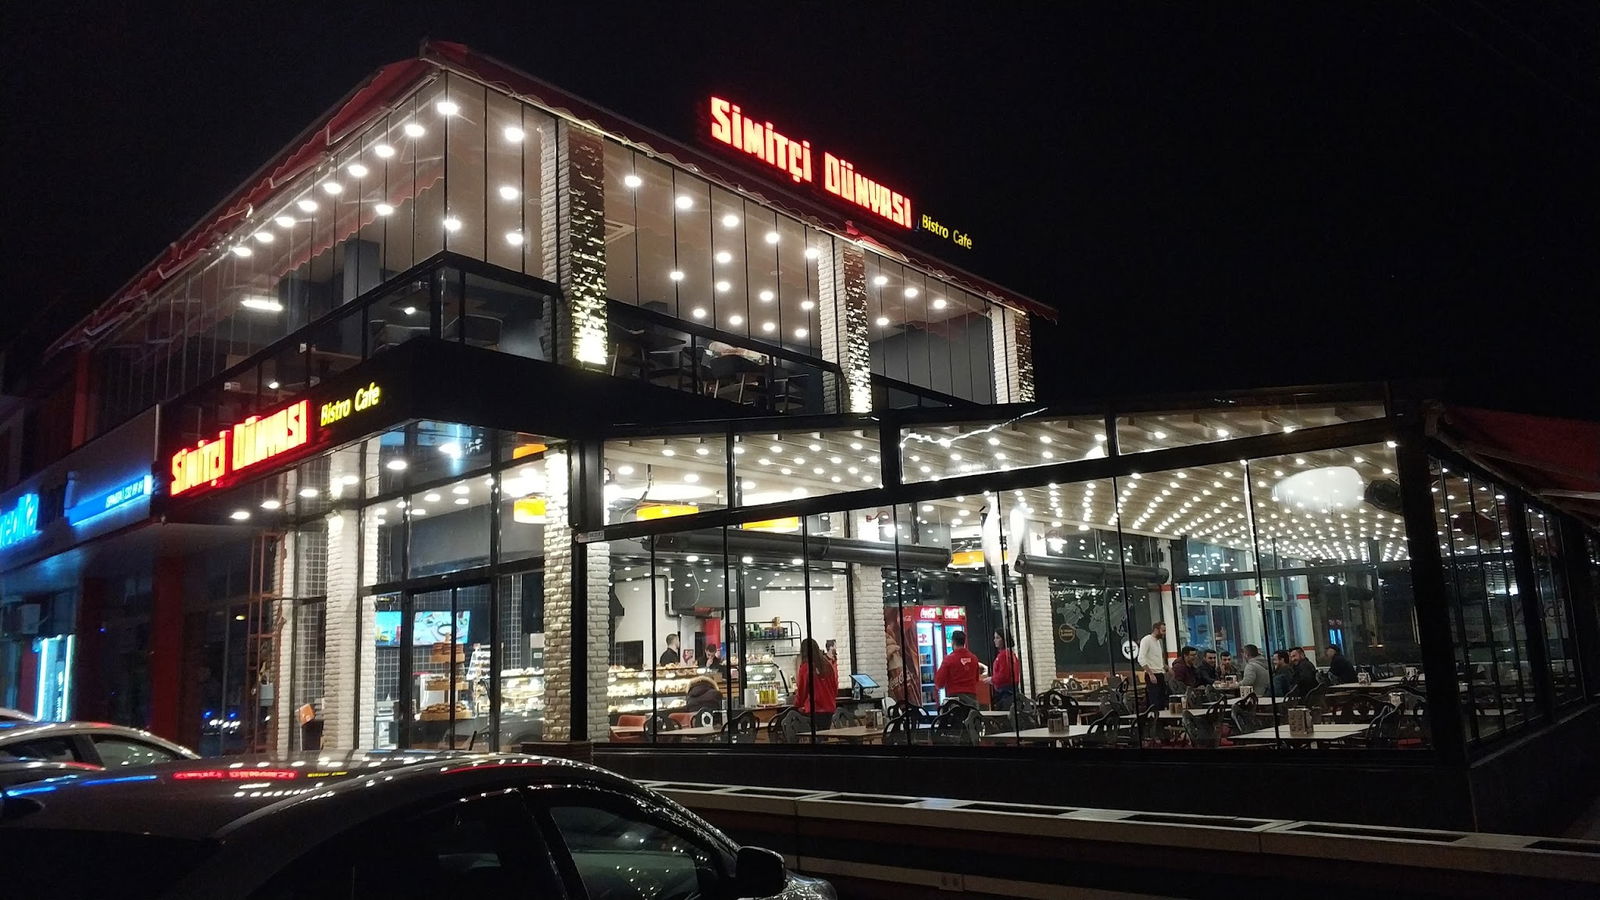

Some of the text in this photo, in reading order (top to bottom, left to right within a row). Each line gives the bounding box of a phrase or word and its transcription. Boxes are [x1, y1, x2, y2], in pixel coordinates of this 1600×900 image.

[824, 152, 912, 228] DÜNYASI
[922, 214, 949, 239] Bistro
[952, 228, 973, 249] Cafe
[320, 400, 350, 426] Bistro
[355, 382, 381, 411] Cafe
